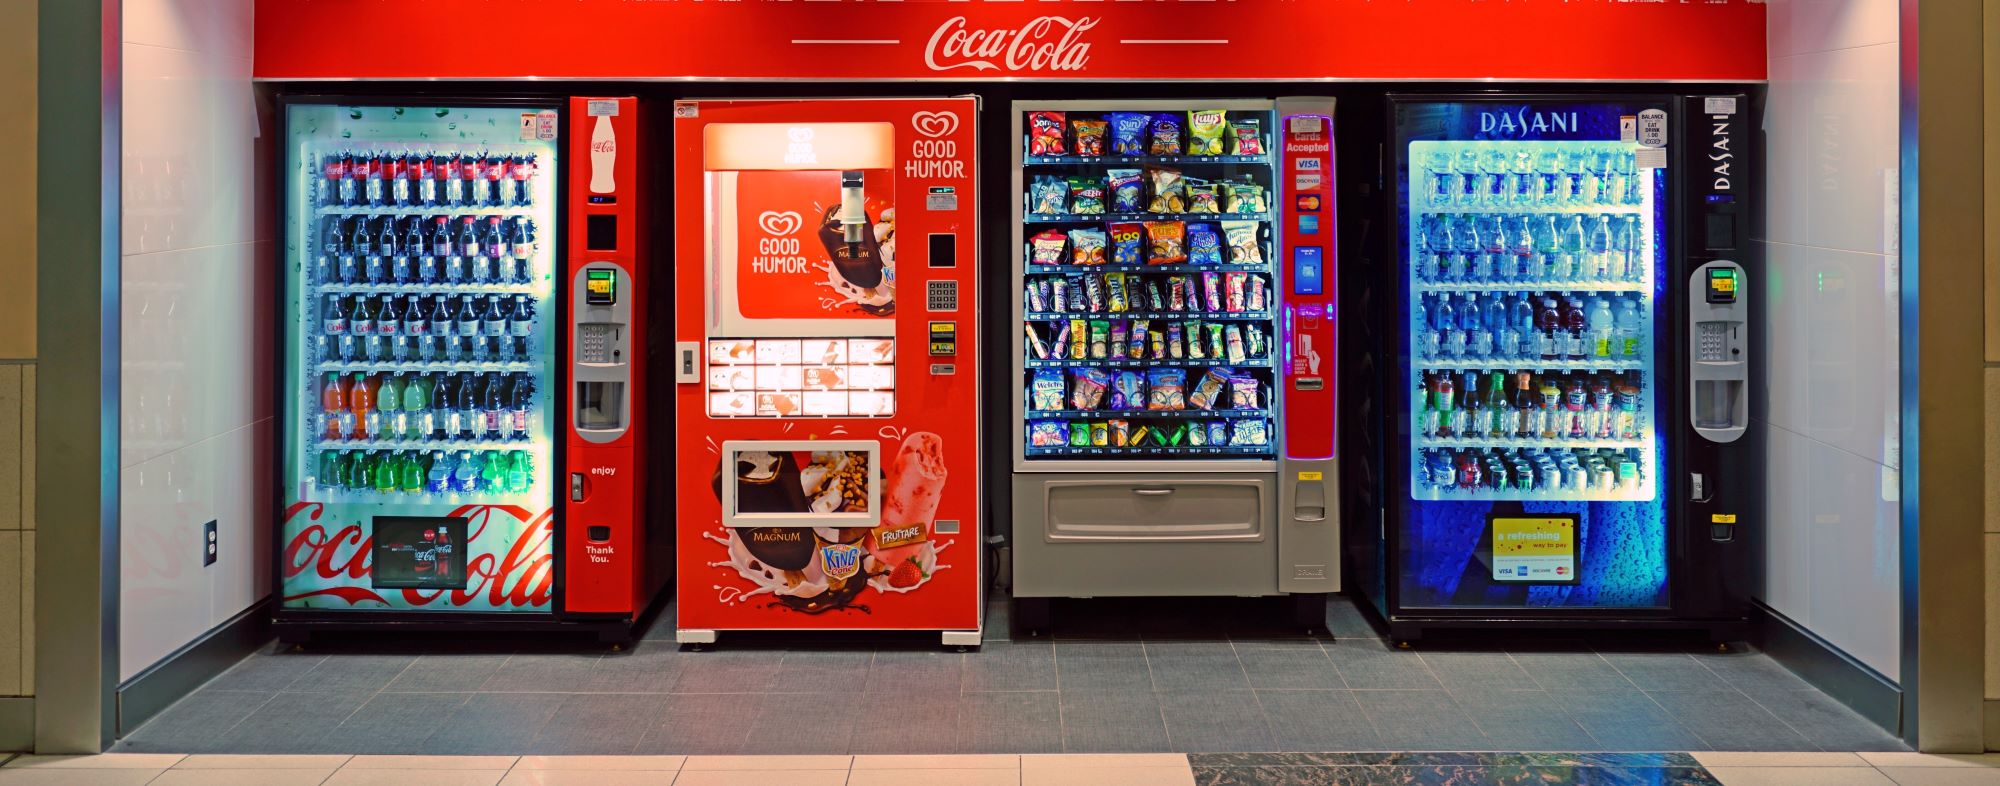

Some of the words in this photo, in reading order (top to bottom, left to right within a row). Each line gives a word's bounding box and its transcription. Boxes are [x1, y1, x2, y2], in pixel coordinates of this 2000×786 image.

[925, 16, 1101, 72] Coca-Cola
[1481, 105, 1577, 138] DASANI
[1295, 132, 1321, 141] Cards
[912, 140, 956, 158] GOOD
[1287, 142, 1329, 153] Accepted
[1708, 115, 1734, 190] DASANI
[904, 160, 966, 178] HUMOR
[1299, 160, 1319, 168] VISA
[759, 238, 800, 255] GOOD
[752, 256, 808, 273] HUMOR
[591, 466, 616, 476] enjoy
[753, 532, 800, 542] MAGNUM
[881, 526, 920, 545] FRUTTARE
[1498, 533, 1504, 541] a
[1507, 531, 1560, 541] refreshing
[586, 545, 614, 554] Thank
[590, 555, 609, 563] You.
